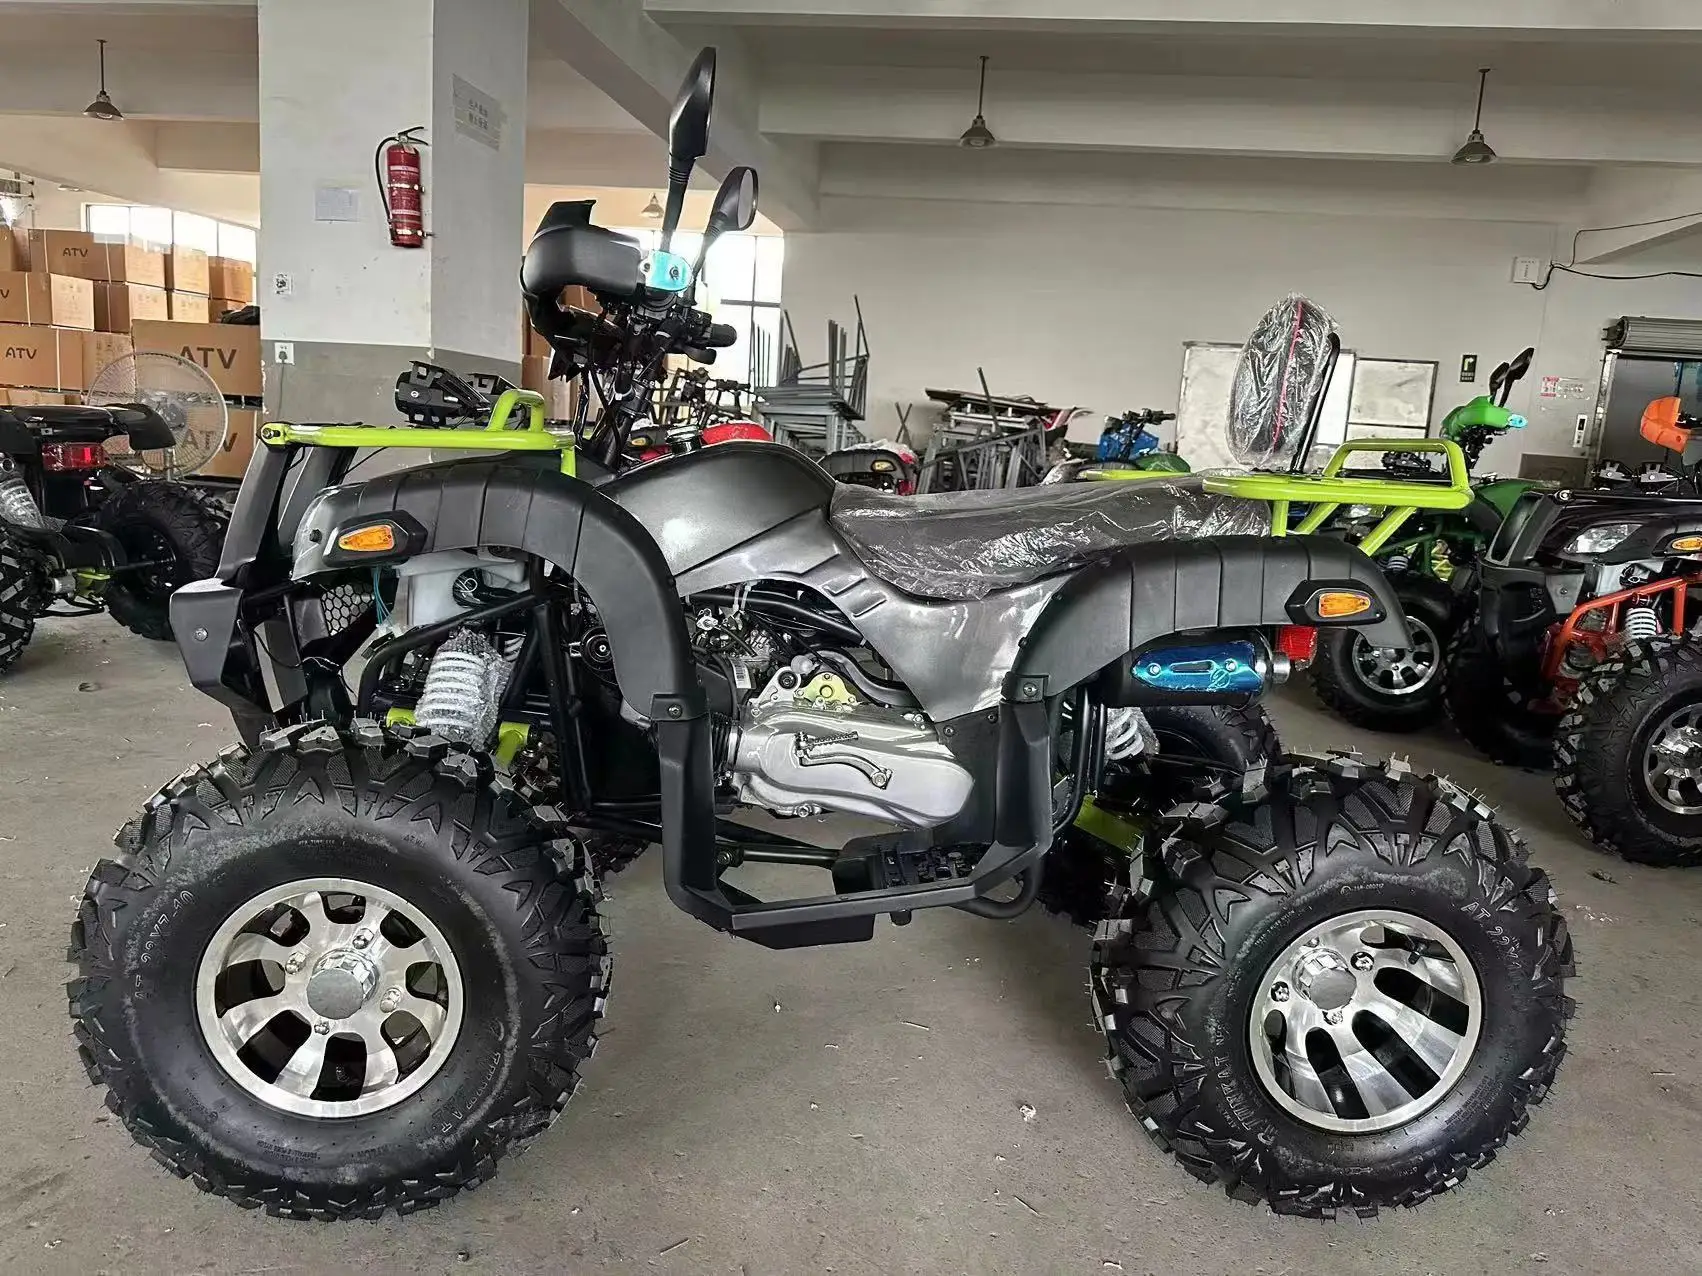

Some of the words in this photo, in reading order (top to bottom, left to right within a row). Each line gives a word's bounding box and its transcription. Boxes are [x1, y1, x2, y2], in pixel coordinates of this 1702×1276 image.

[62, 247, 89, 258] ATV
[5, 346, 38, 360] ATV
[178, 345, 238, 370] ATV
[181, 428, 239, 453] ATV
